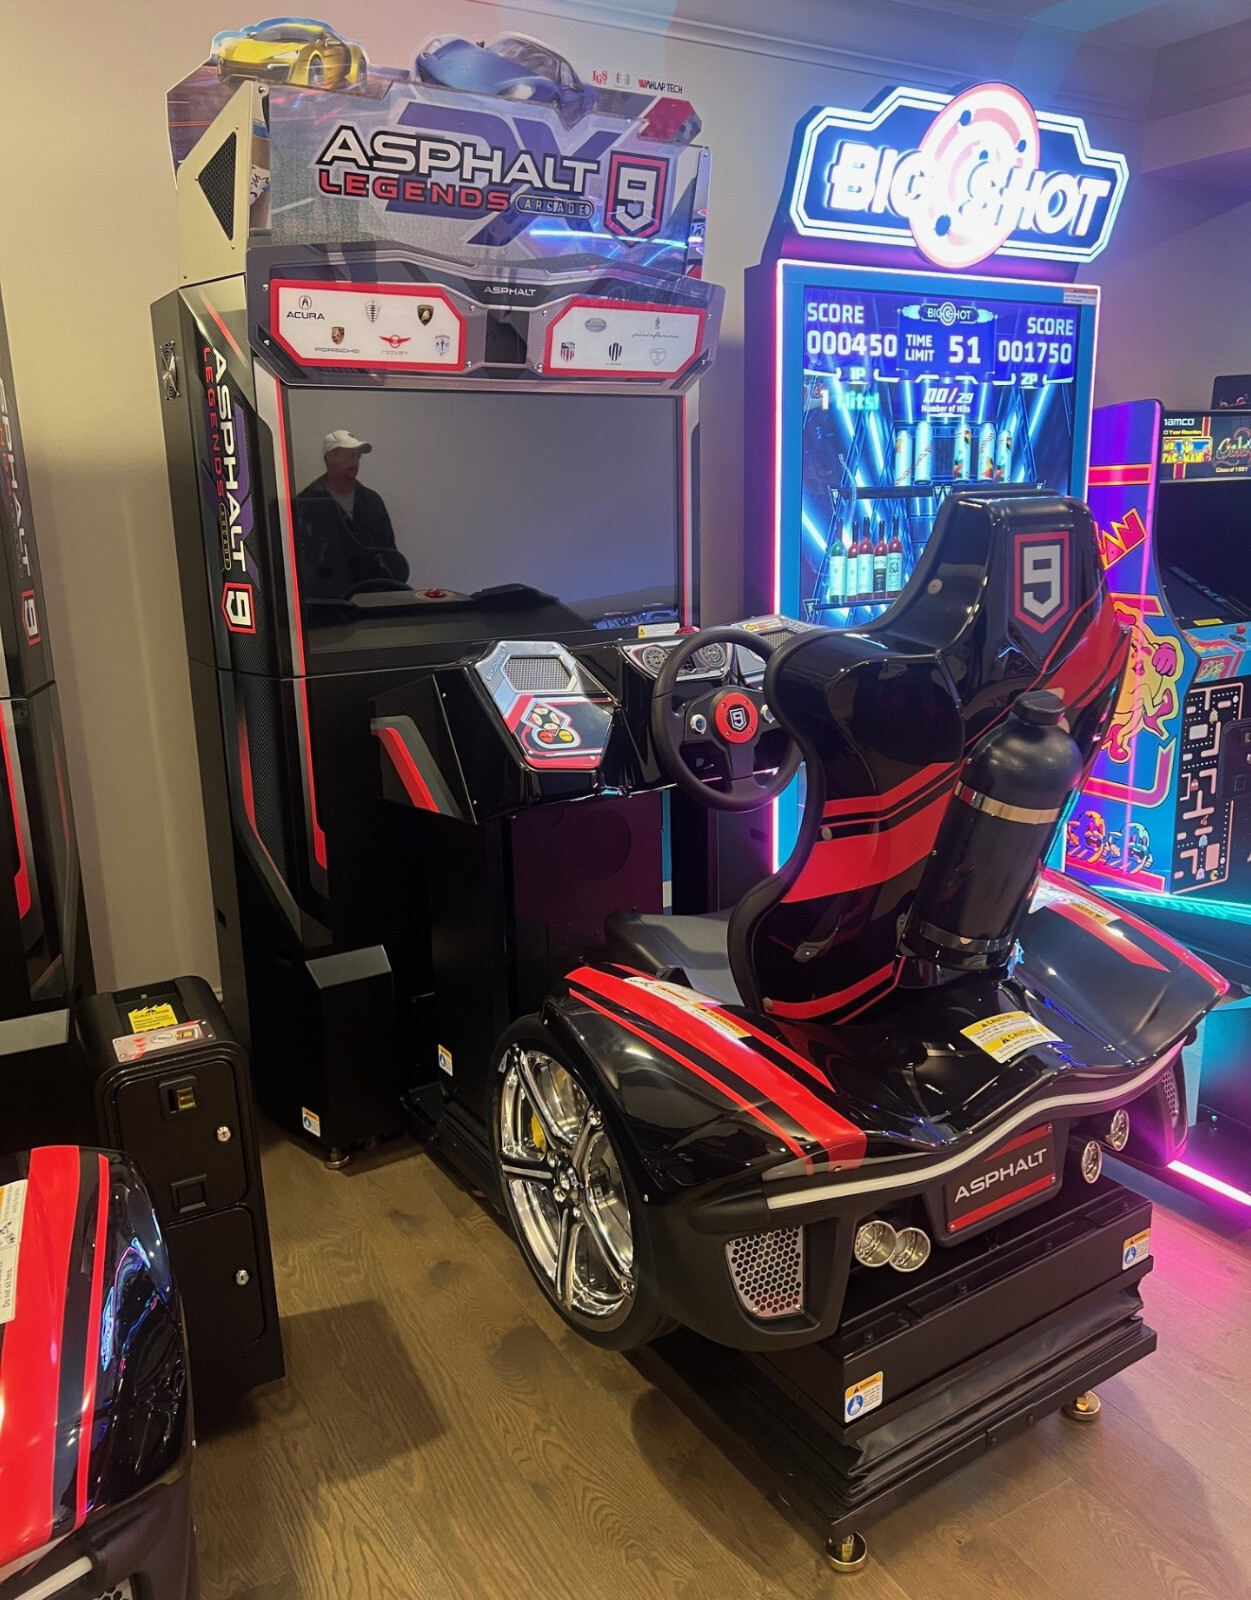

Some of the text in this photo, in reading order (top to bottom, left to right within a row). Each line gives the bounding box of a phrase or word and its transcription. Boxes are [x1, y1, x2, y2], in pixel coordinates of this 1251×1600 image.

[667, 83, 683, 94] TECH
[318, 126, 600, 195] ASPHALT
[318, 169, 512, 213] LEGENDS
[613, 165, 659, 234] 9
[825, 139, 1112, 237] BIG SHOT
[523, 198, 587, 215] ARCADE
[484, 286, 537, 297] ASPHALT
[286, 311, 325, 321] ACURA
[807, 302, 865, 324] SCORE
[1027, 317, 1074, 336] SCORE
[806, 330, 897, 358] 000450
[906, 334, 933, 347] TIME
[948, 336, 982, 364] 51
[998, 340, 1073, 364] 001750
[905, 348, 936, 362] LIMIT
[849, 367, 866, 380] 1P
[820, 389, 830, 410] 1
[921, 404, 948, 413] Number
[948, 404, 956, 412] of
[203, 347, 226, 498] LEGENDS
[212, 348, 247, 572] ASPHALT
[1023, 544, 1061, 619] 9
[226, 590, 252, 627] 9
[954, 1148, 1047, 1203] ASPHALT
